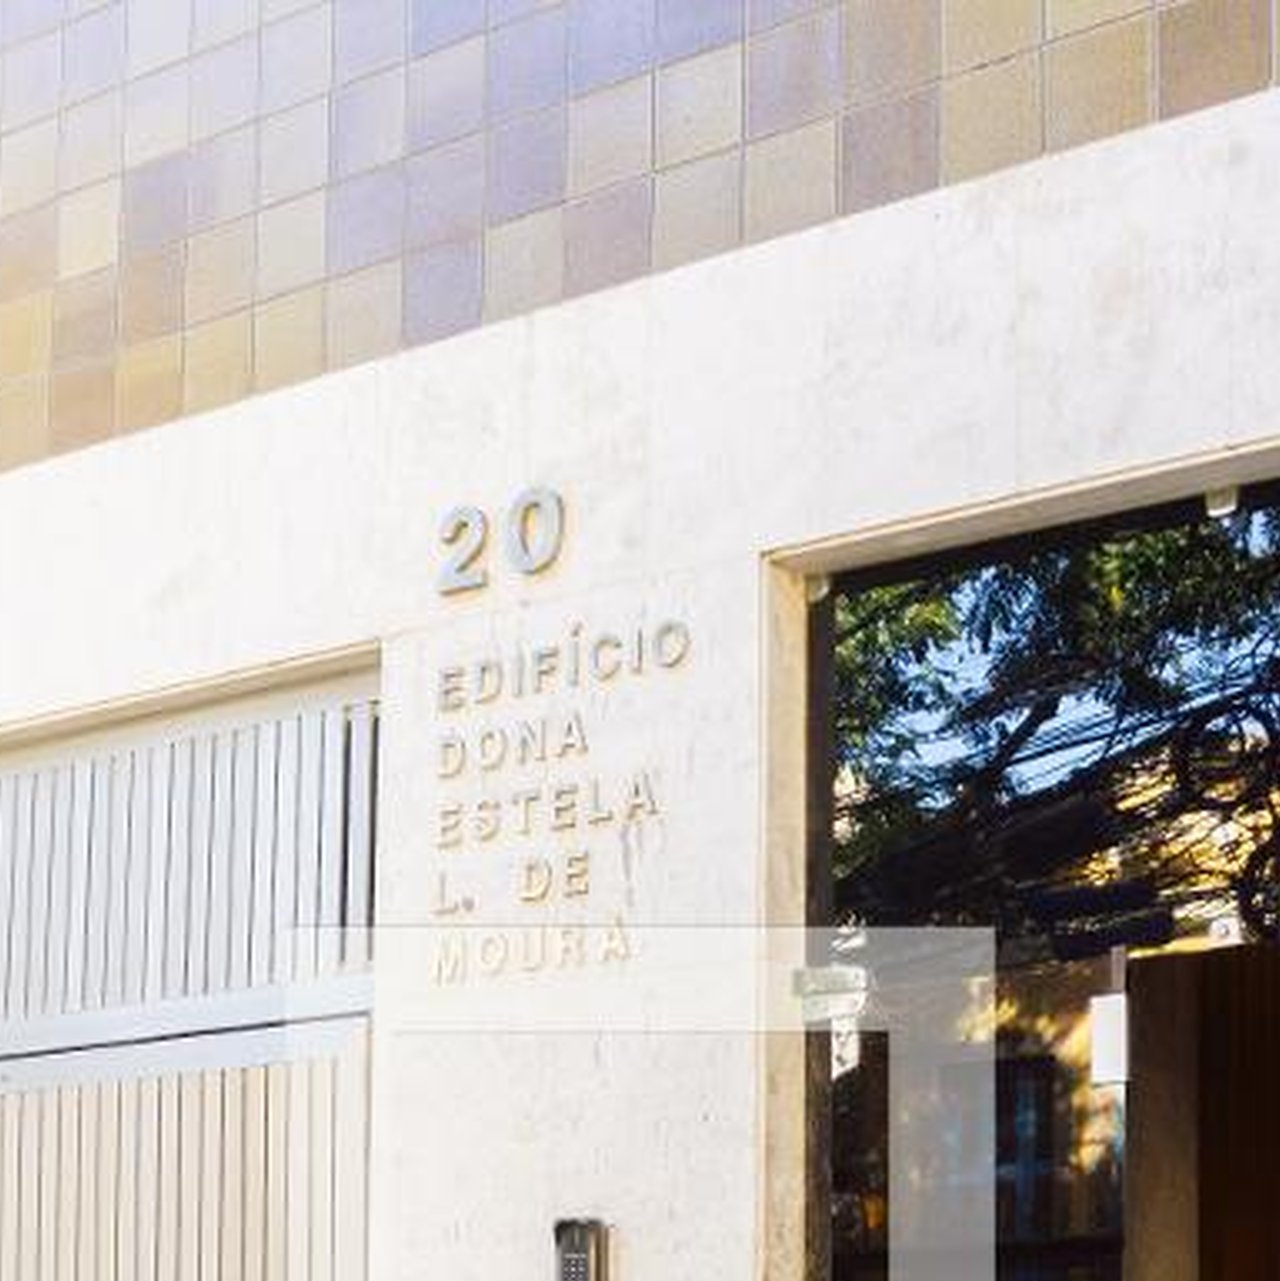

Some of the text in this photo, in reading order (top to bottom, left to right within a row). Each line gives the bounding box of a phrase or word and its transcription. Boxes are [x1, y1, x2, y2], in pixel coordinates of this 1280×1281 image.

[438, 486, 564, 596] 20
[436, 621, 692, 711] EDIFÍCIO
[436, 713, 589, 779] DONA
[435, 773, 660, 849] ESTELA
[433, 853, 590, 917] L. DE
[431, 917, 633, 986] MOURA
